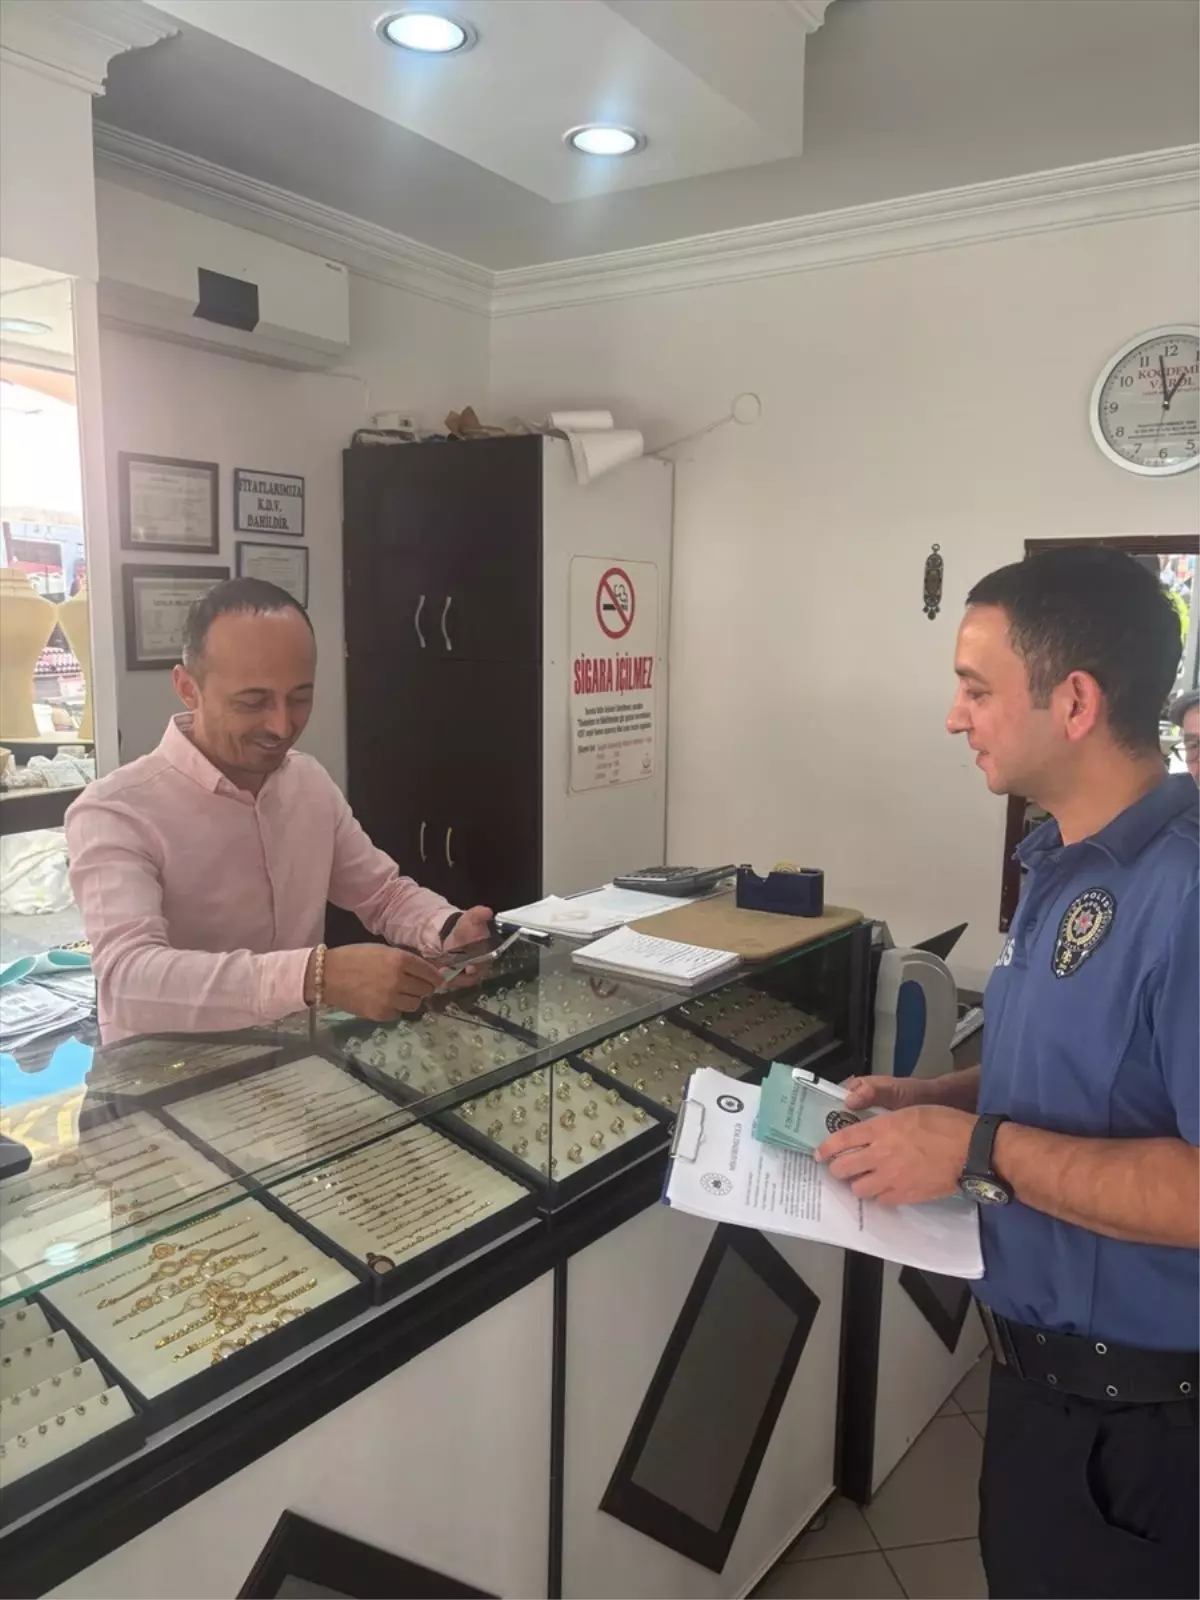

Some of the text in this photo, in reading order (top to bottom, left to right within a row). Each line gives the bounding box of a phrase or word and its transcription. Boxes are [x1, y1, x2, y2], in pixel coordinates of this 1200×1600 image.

[1164, 344, 1179, 357] 12
[1139, 356, 1150, 368] 11
[1120, 375, 1134, 388] 10
[1109, 402, 1119, 414] 9
[1115, 426, 1125, 438] 8
[1132, 443, 1142, 454] 7
[1185, 439, 1196, 450] 5
[1159, 448, 1168, 459] 6
[574, 651, 654, 697] SİGARA İÇİLMEZ
